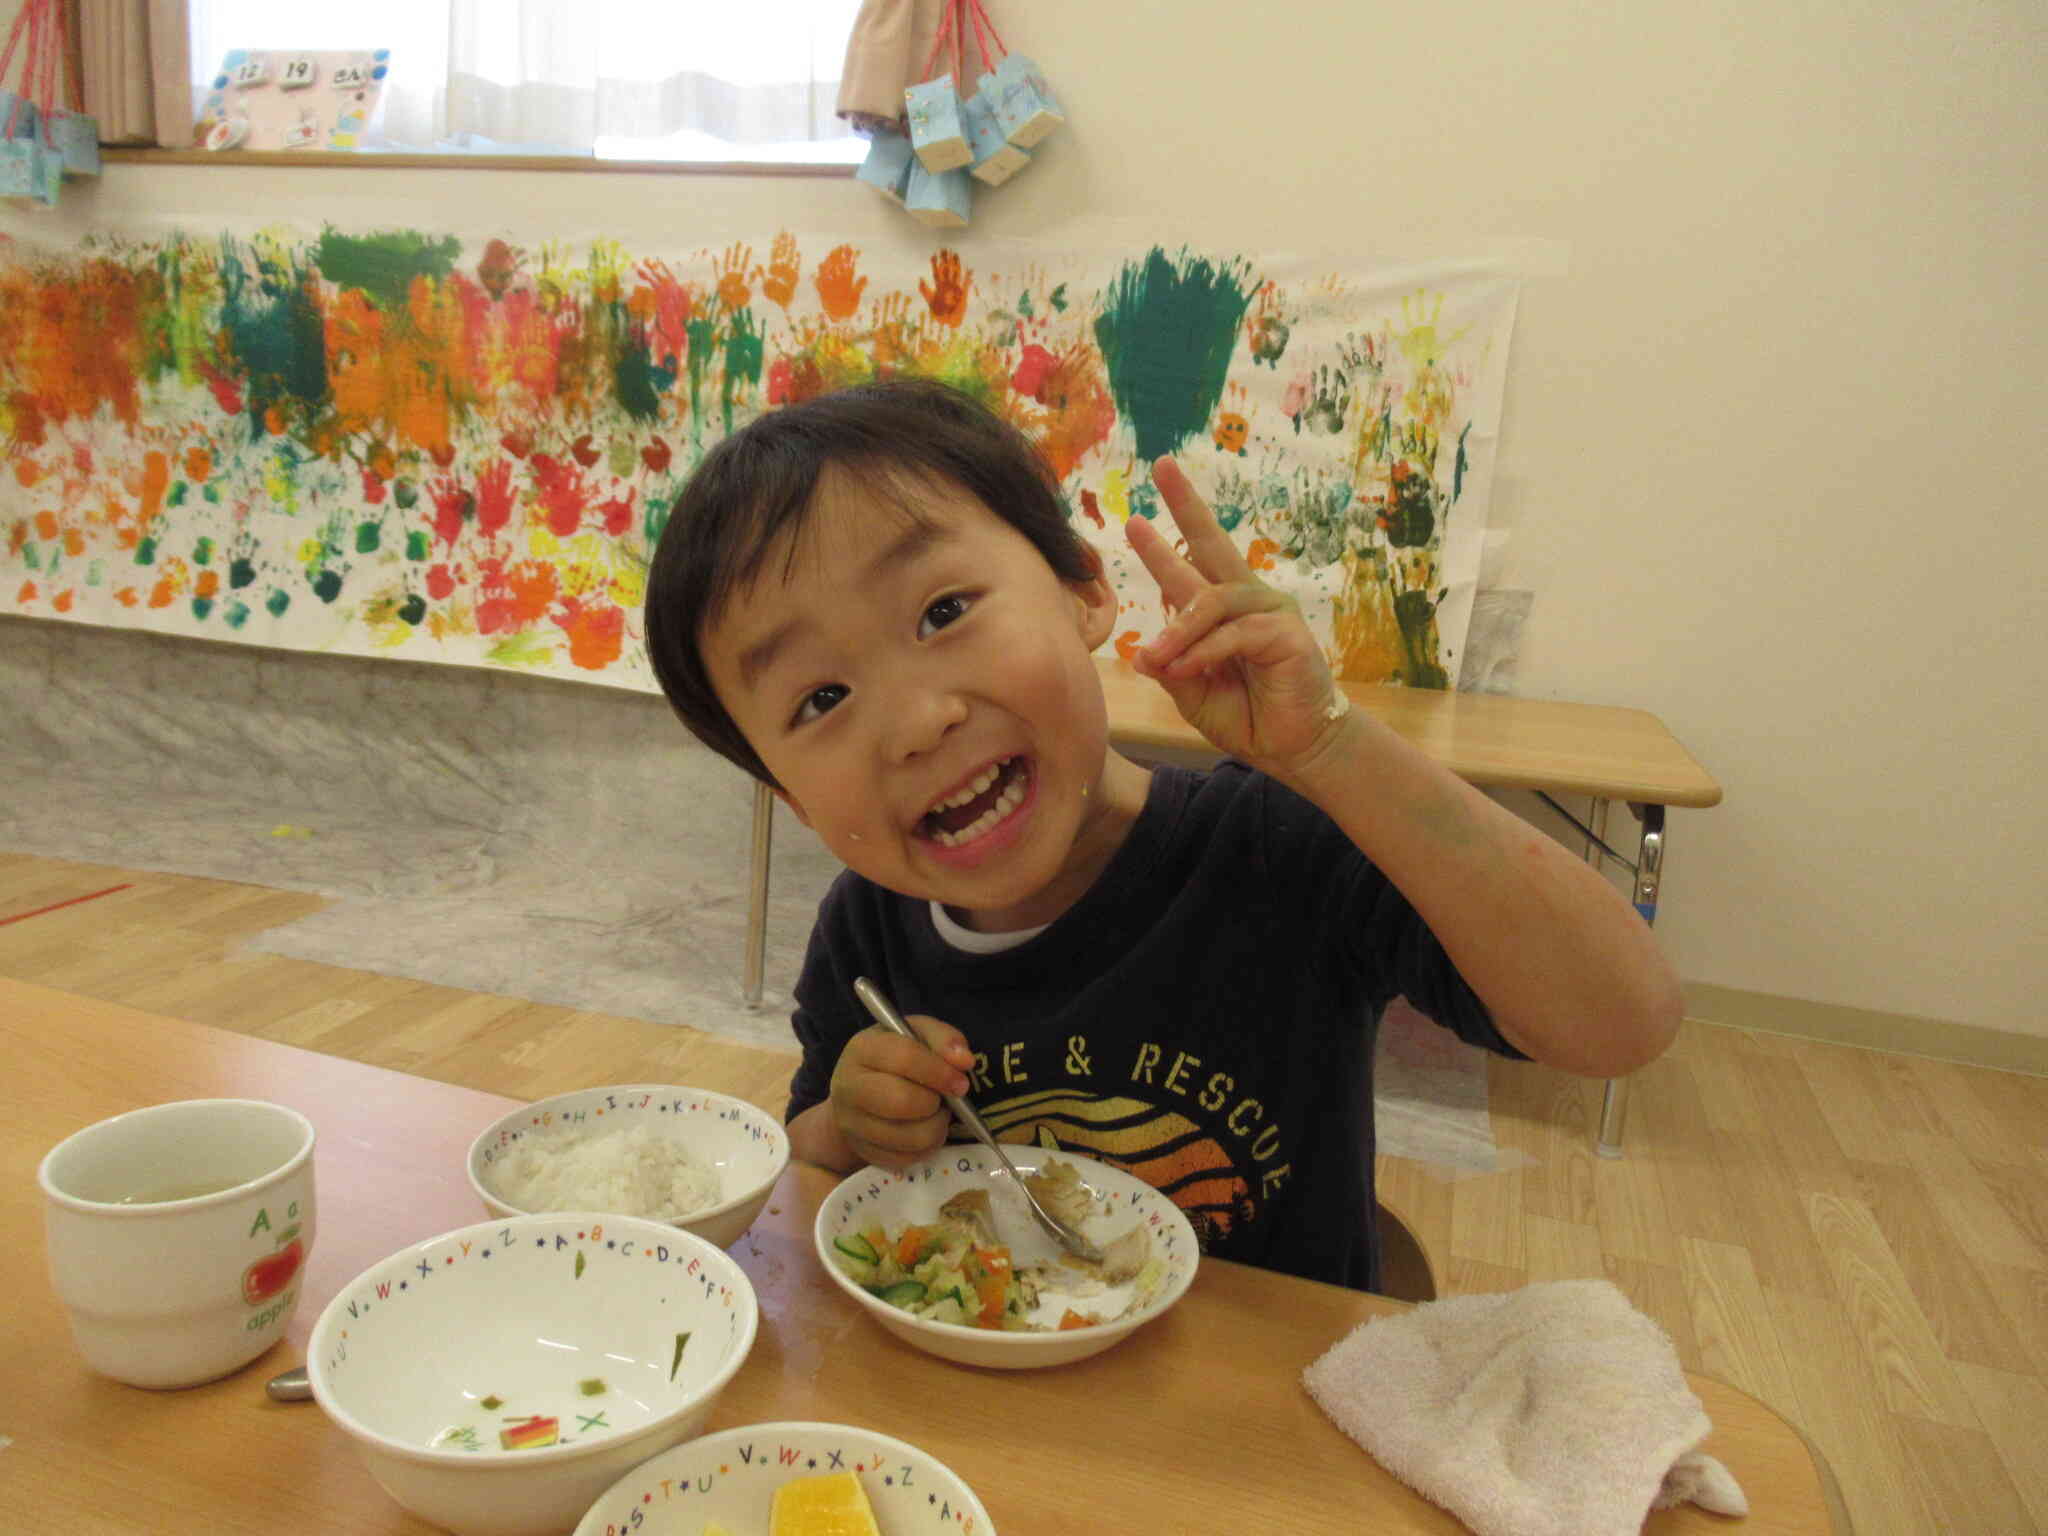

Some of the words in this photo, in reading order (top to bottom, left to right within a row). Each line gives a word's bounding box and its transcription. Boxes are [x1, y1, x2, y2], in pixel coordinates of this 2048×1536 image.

[286, 61, 309, 78] 19
[574, 1109, 586, 1124] H
[606, 1095, 617, 1110] I
[639, 1094, 653, 1109] J
[673, 1100, 685, 1113] K
[728, 1108, 741, 1121] M
[970, 1041, 1027, 1094] RE
[1064, 1035, 1093, 1076] &
[1131, 1042, 1291, 1200] RESCUE
[957, 1158, 974, 1172] Q
[250, 1207, 271, 1239] A
[347, 1300, 360, 1319] V
[375, 1279, 392, 1301] W
[415, 1257, 434, 1281] X
[459, 1240, 473, 1257] Y
[498, 1228, 517, 1248] Z
[554, 1234, 569, 1252] A
[589, 1223, 604, 1243] B
[620, 1240, 636, 1257] C
[657, 1245, 670, 1263] D
[686, 1256, 702, 1278] E
[705, 1281, 716, 1300] F
[630, 1505, 645, 1529] S
[660, 1479, 675, 1499] T
[697, 1472, 714, 1494] U
[738, 1444, 754, 1465] V
[778, 1444, 802, 1468] W
[826, 1449, 846, 1470] X
[901, 1466, 915, 1487] Z
[941, 1500, 953, 1522] A
